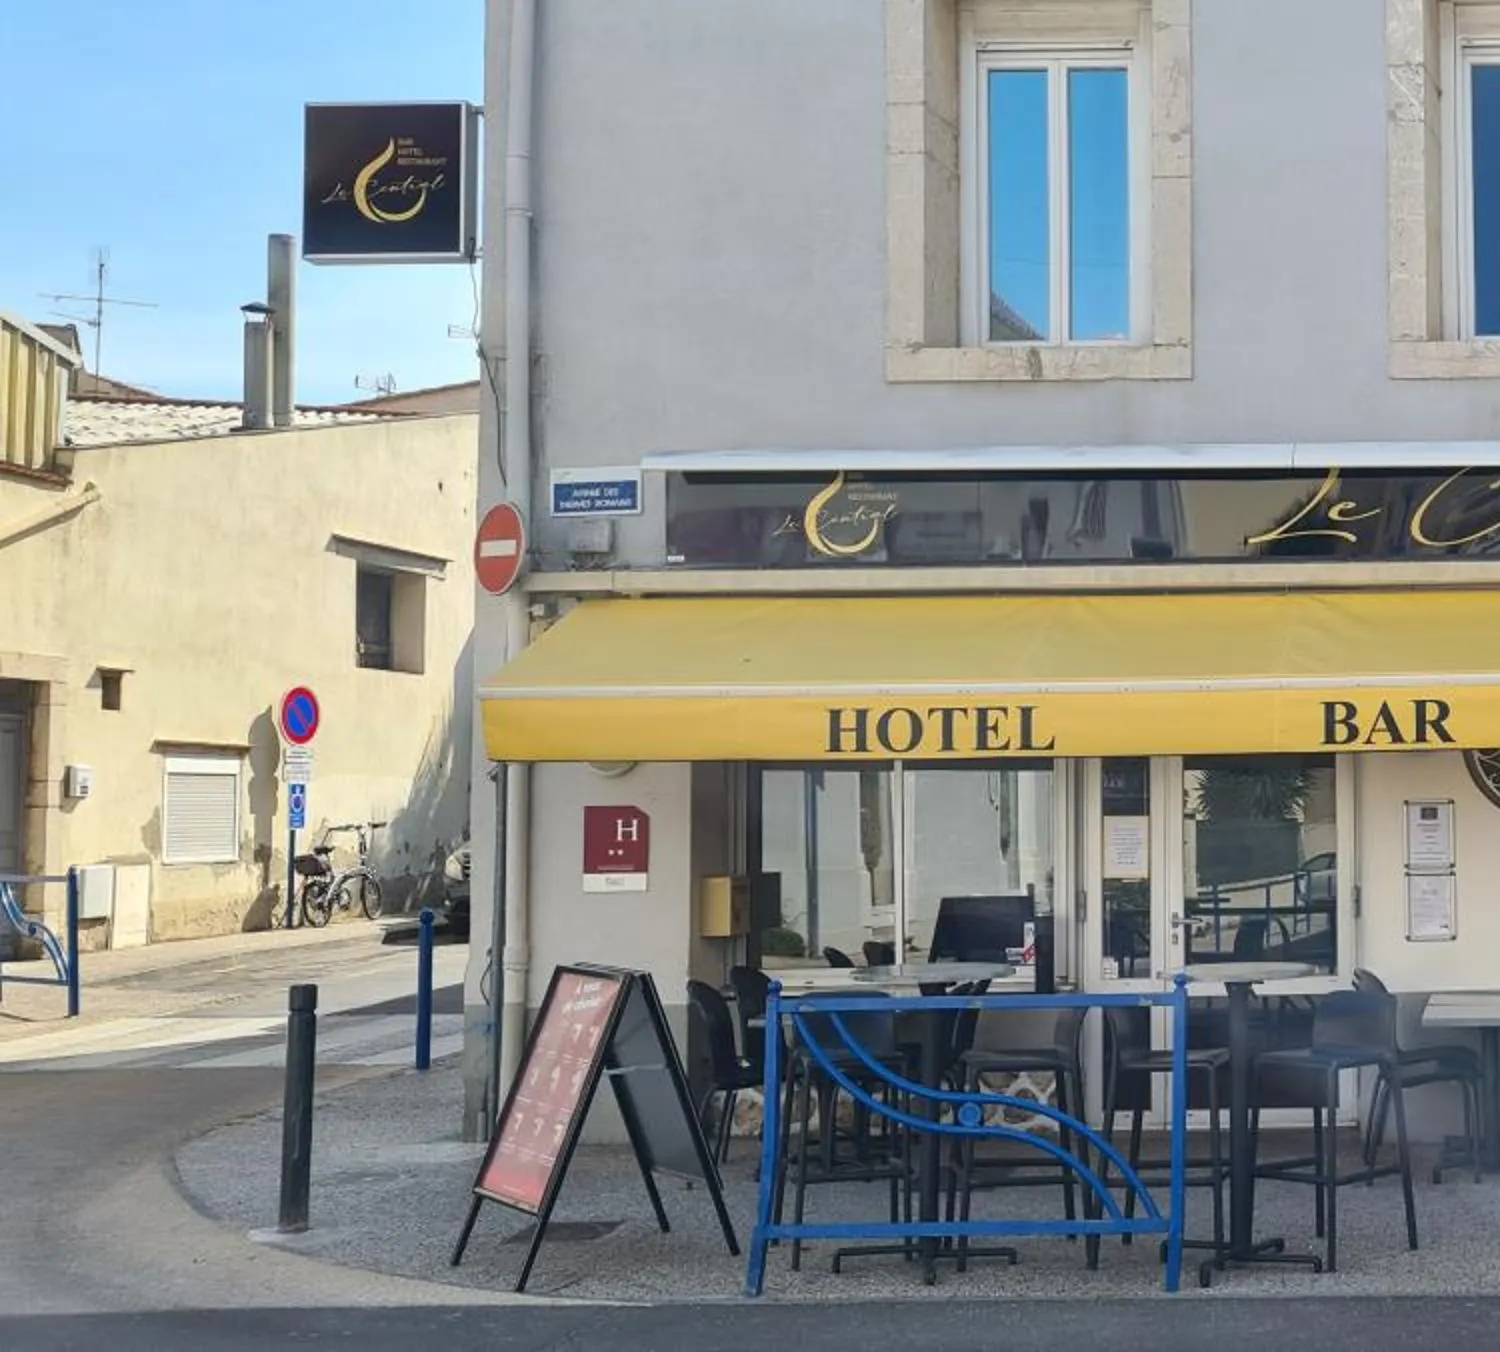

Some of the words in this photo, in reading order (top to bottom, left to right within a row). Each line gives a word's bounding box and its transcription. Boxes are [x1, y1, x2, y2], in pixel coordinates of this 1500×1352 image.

[1245, 464, 1382, 544] Le
[825, 705, 1057, 753] HOTEL
[1320, 699, 1457, 746] BAR
[615, 819, 639, 841] H
